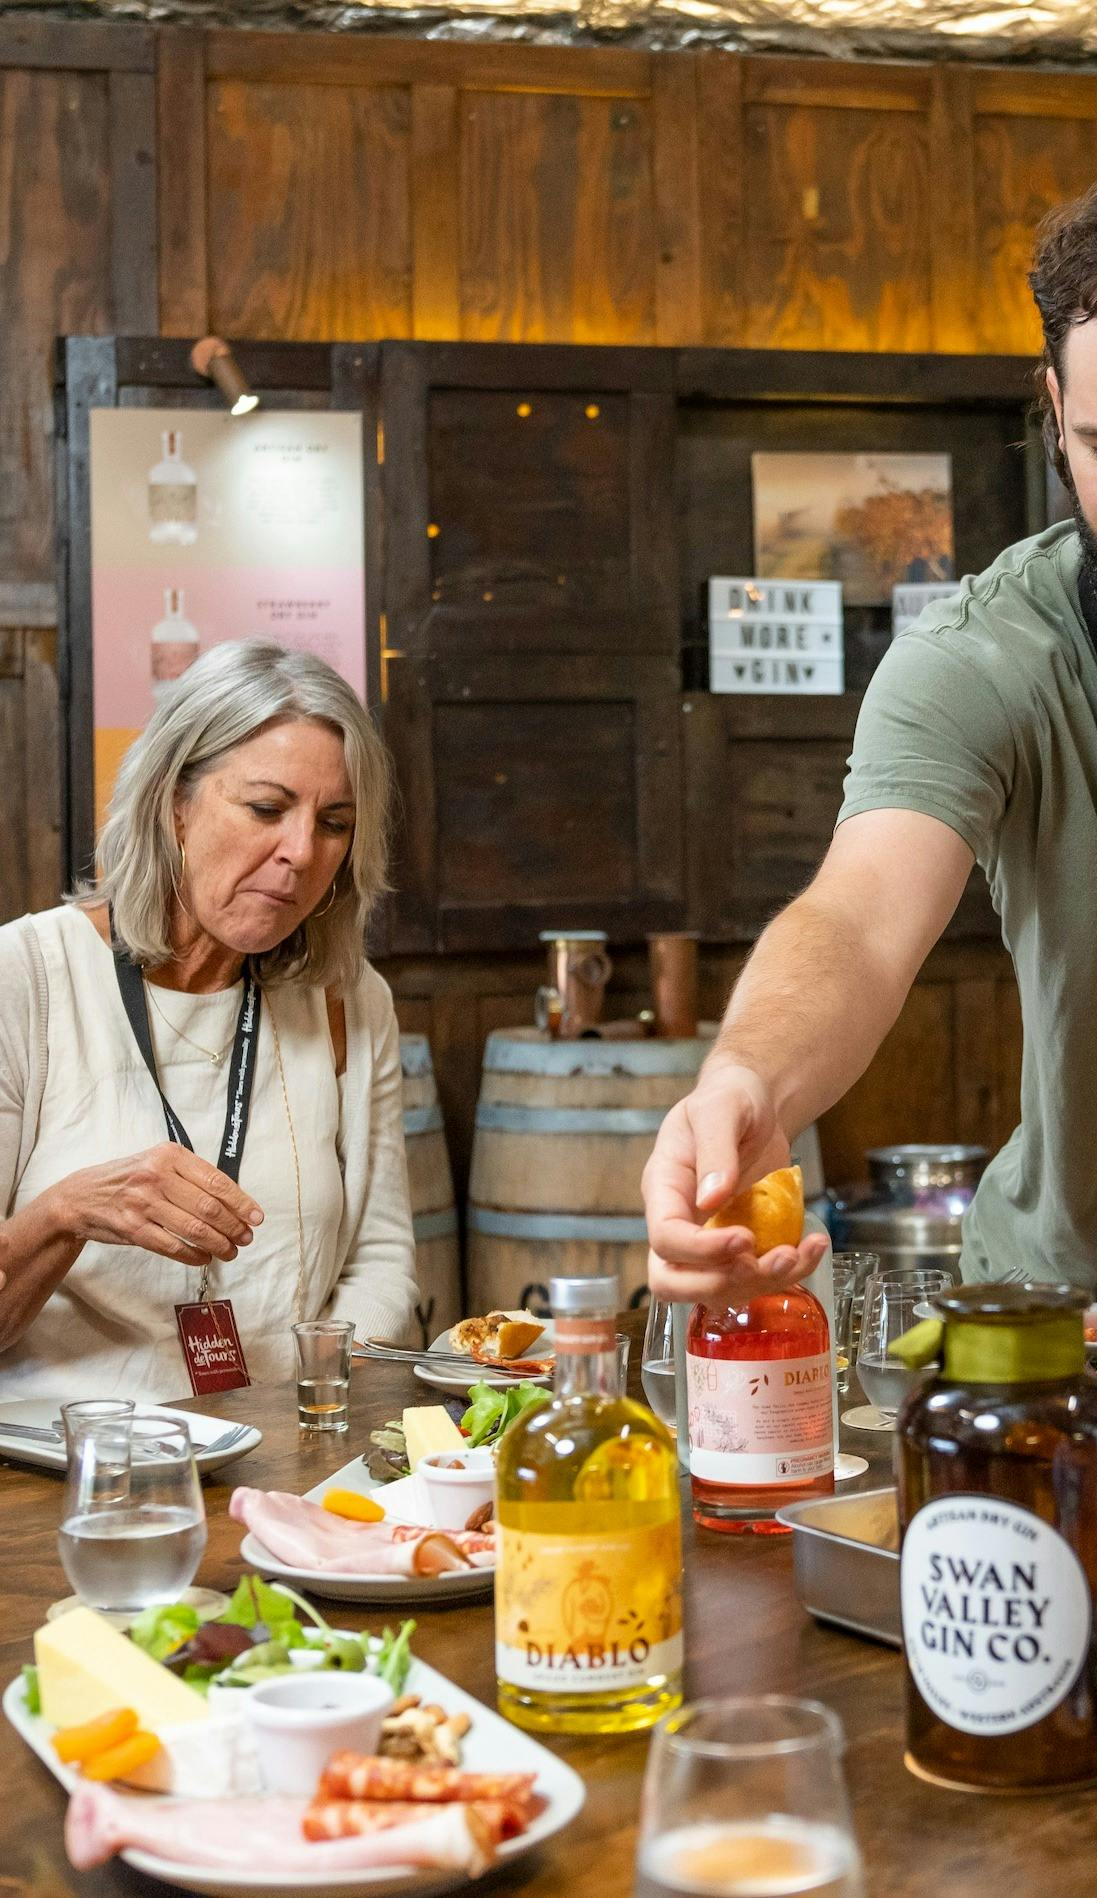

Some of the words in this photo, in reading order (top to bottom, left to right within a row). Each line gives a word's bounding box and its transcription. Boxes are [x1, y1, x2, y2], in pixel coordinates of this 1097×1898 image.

[188, 1333, 234, 1353] Hidden
[929, 1553, 1037, 1592] SWAN
[921, 1585, 1050, 1627] VALLEY
[526, 1637, 650, 1669] DIABLO
[921, 1621, 975, 1658] GIN
[987, 1632, 1050, 1663] CO.
